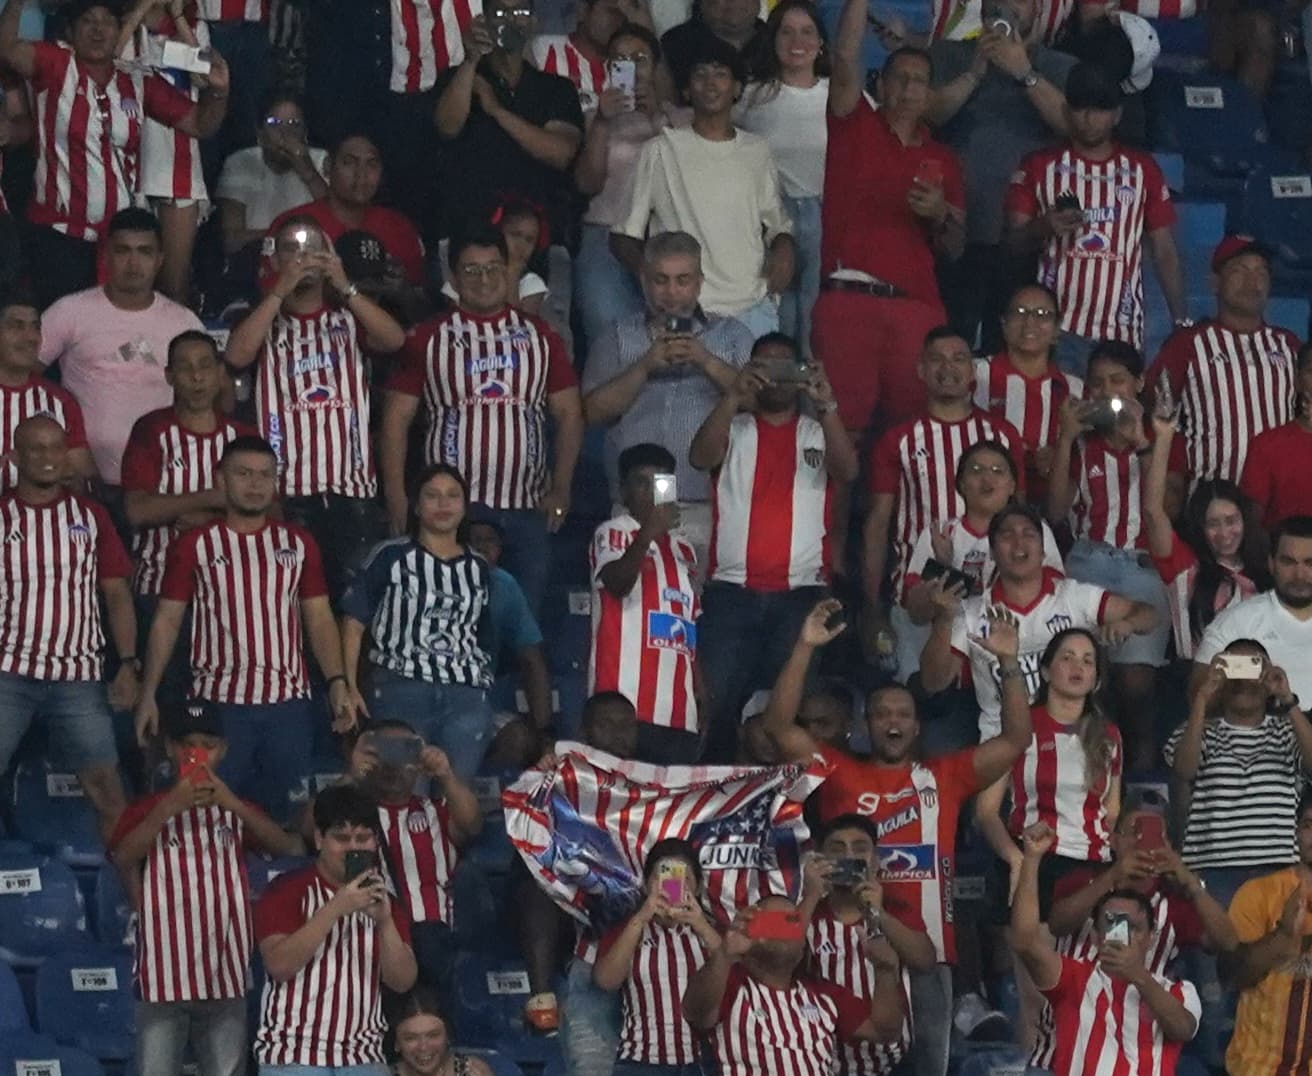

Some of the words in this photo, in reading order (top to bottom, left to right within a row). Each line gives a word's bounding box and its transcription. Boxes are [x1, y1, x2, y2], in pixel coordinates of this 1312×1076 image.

[469, 355, 518, 375] AGUILA
[855, 792, 880, 816] 9
[876, 807, 921, 839] AGUILA
